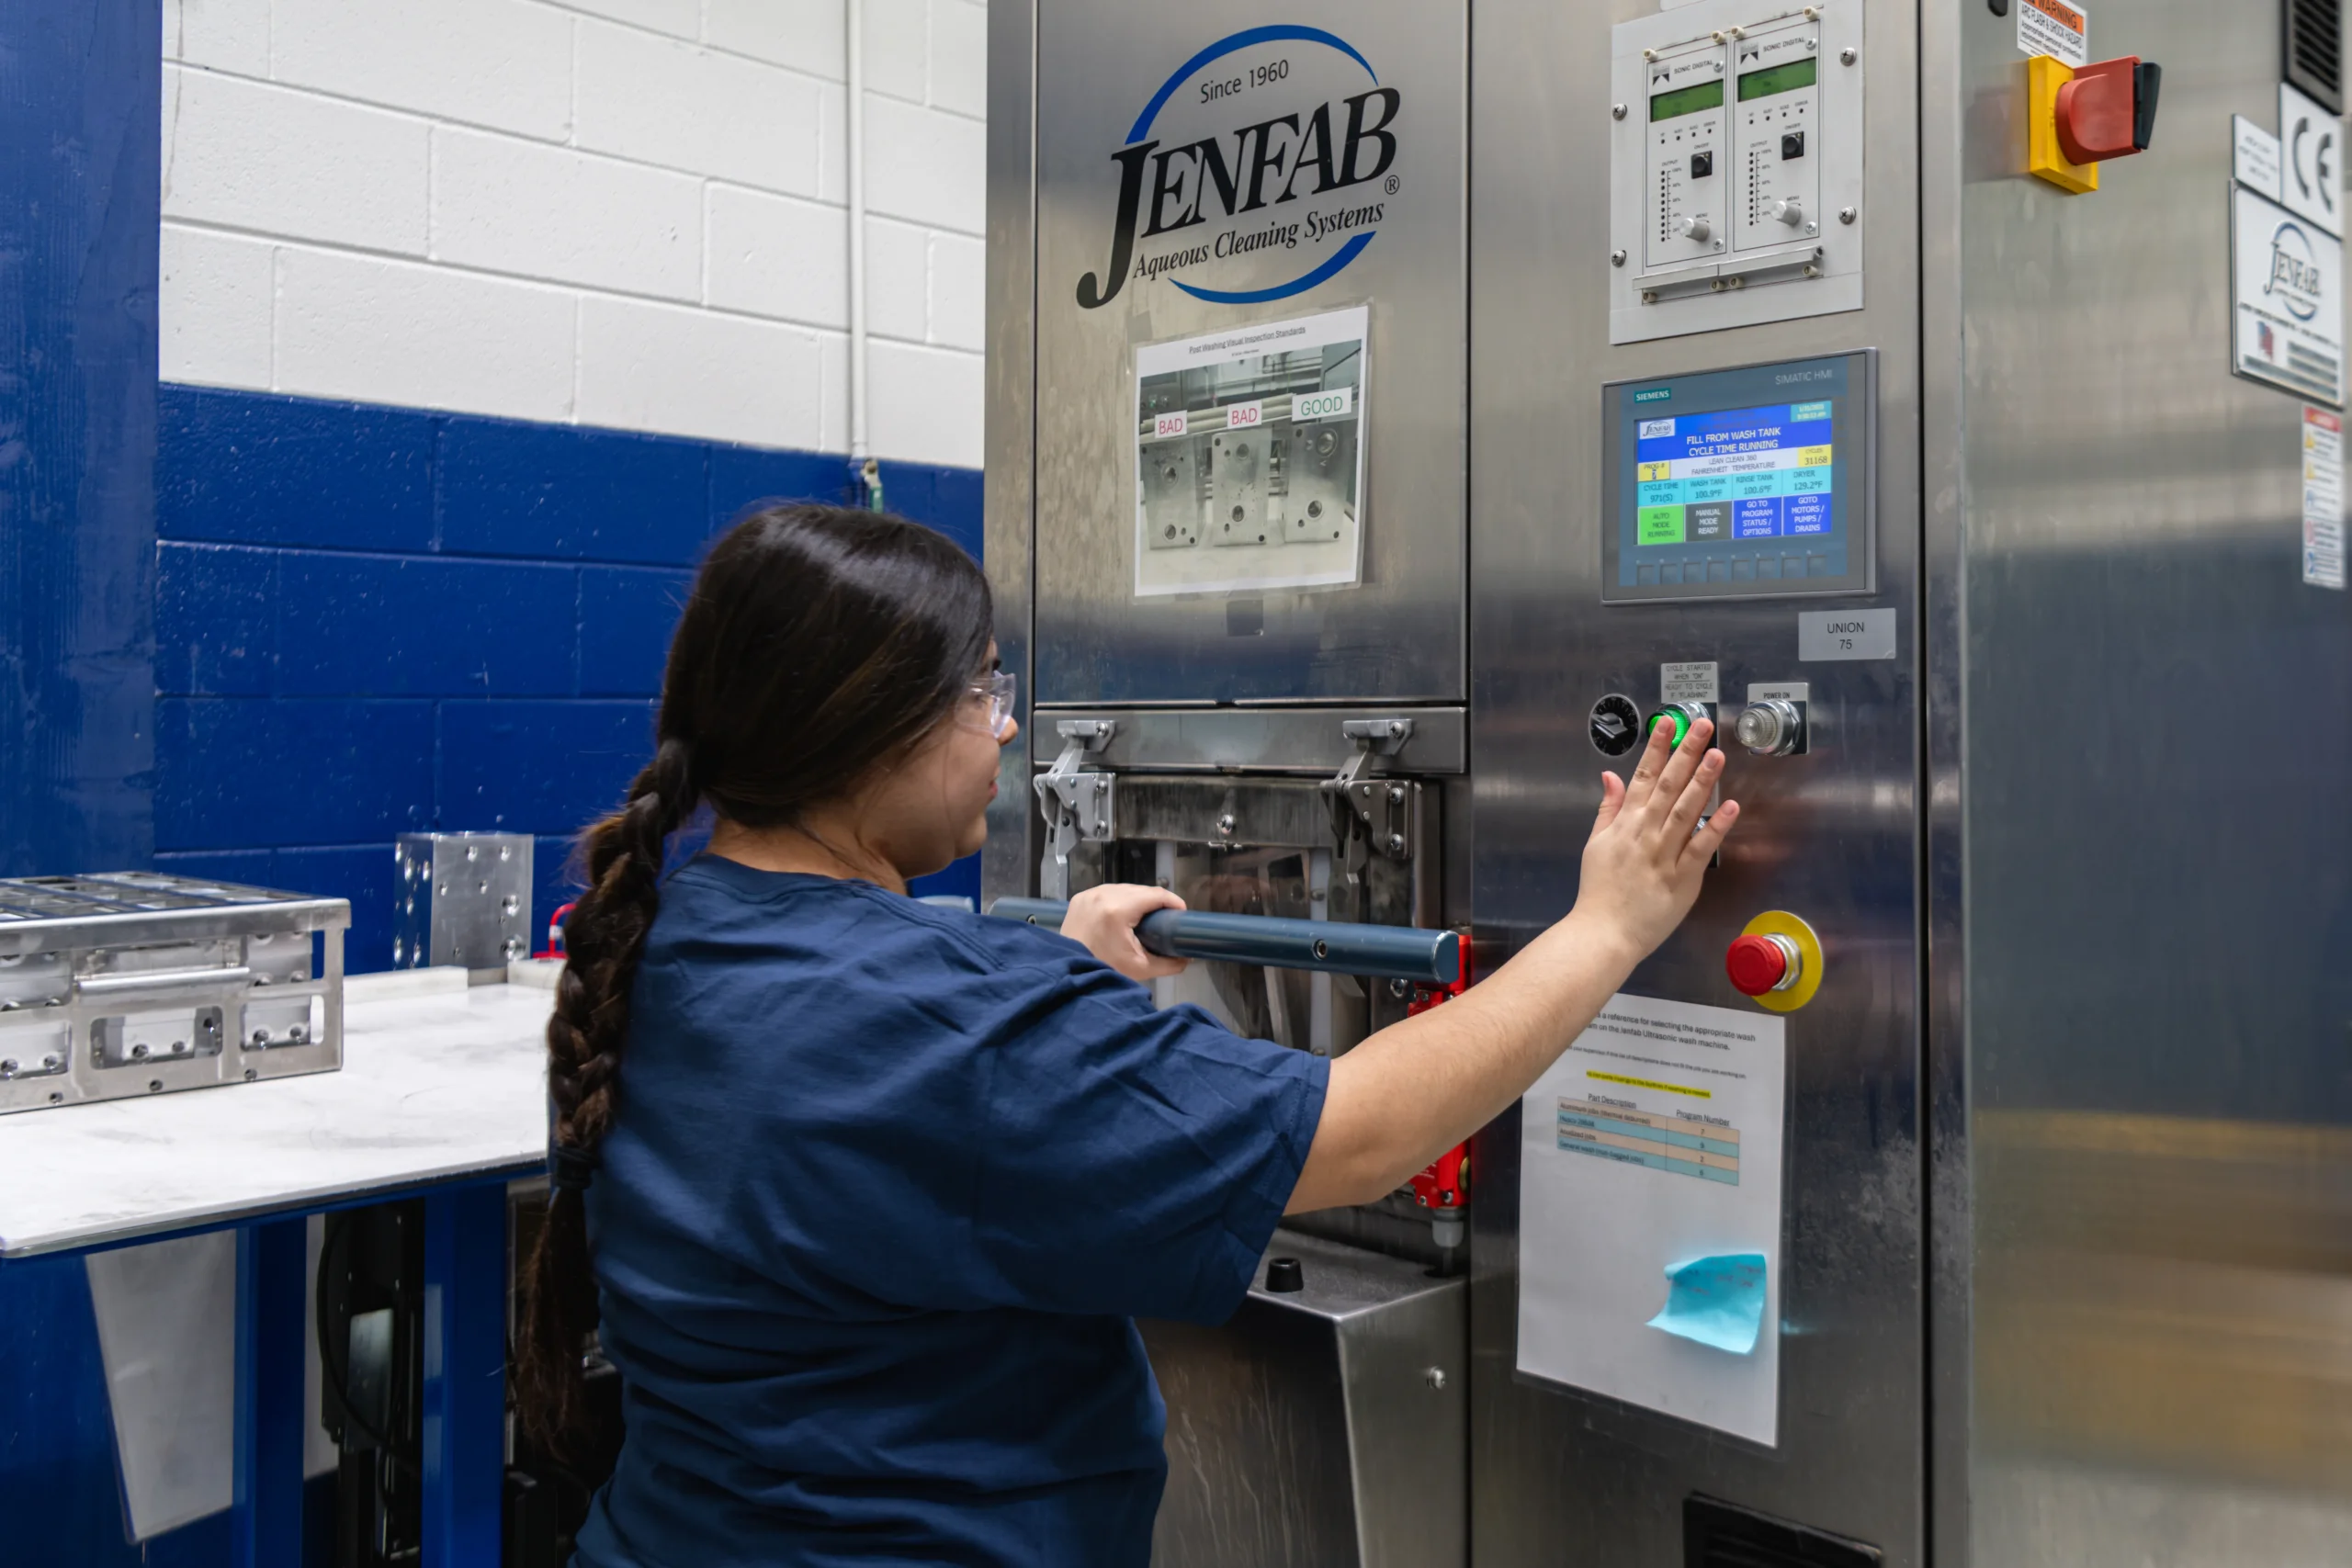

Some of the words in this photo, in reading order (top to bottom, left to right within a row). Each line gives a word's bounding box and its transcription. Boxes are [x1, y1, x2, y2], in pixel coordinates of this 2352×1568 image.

[2039, 0, 2076, 28] WARNING
[1763, 42, 1781, 52] SONIC
[1782, 37, 1804, 48] DIGITAL
[1674, 65, 1690, 74] SONIC
[1692, 60, 1714, 70] DIGITAL
[1201, 77, 1241, 104] Since
[1249, 59, 1289, 88] 1960
[1076, 87, 1400, 310] JENFAB
[1134, 243, 1209, 281] Aqueous
[1215, 220, 1299, 259] Cleaning
[1304, 202, 1385, 242] Systems
[1189, 345, 1202, 355] Post
[1202, 341, 1227, 353] Washing
[1226, 336, 1243, 347] Visual
[1245, 331, 1274, 344] Inspection
[1275, 326, 1306, 338] Standards
[1775, 371, 1811, 385] SIMATIC
[1814, 369, 1833, 379] HMI
[1636, 389, 1669, 401] SIEMENS
[1301, 396, 1343, 415] GOOD
[1231, 408, 1258, 424] BAD
[1159, 418, 1182, 434] BAD
[1686, 435, 1703, 445] FILL
[1705, 433, 1728, 443] FROM
[1731, 429, 1756, 440] WASH
[1758, 427, 1781, 437] TANK
[1689, 446, 1713, 457] CYCLE
[1715, 443, 1736, 454] TIME
[1739, 439, 1779, 451] RUNNING
[1725, 456, 1744, 464] CLEAN
[1746, 454, 1757, 462] 360
[1804, 456, 1827, 466] 31168
[1691, 466, 1727, 475] FAHRENHEIT
[1733, 461, 1775, 472] TEMPERATURE
[1736, 475, 1755, 483] RINSE
[1798, 496, 1817, 504] GOTO
[1695, 508, 1721, 517] MANUAL
[1742, 509, 1773, 518] PROGRAM
[1792, 505, 1820, 514] MOTORS
[1699, 517, 1718, 525] MODE
[1743, 519, 1767, 527] STATUS
[1794, 515, 1816, 524] PUMPS
[1647, 530, 1676, 538] RUNNING
[1698, 526, 1719, 535] READY
[1743, 527, 1771, 536] OPTIONS
[1795, 525, 1820, 533] DRAINS
[1826, 622, 1864, 634] UNION
[1839, 638, 1852, 649] 75
[1608, 1013, 1639, 1023] reference
[1640, 1017, 1649, 1025] for
[1650, 1019, 1680, 1032] selecting
[1682, 1024, 1693, 1032] the
[1694, 1027, 1736, 1039] appropriate
[1736, 1033, 1756, 1042] wash
[1643, 1030, 1678, 1043] Ultrasonic
[1679, 1036, 1697, 1045] wash
[1698, 1040, 1731, 1051] machine.
[1588, 1093, 1600, 1102] Part
[1601, 1095, 1636, 1110] Description
[1676, 1109, 1702, 1120] Program
[1703, 1114, 1730, 1126] Number
